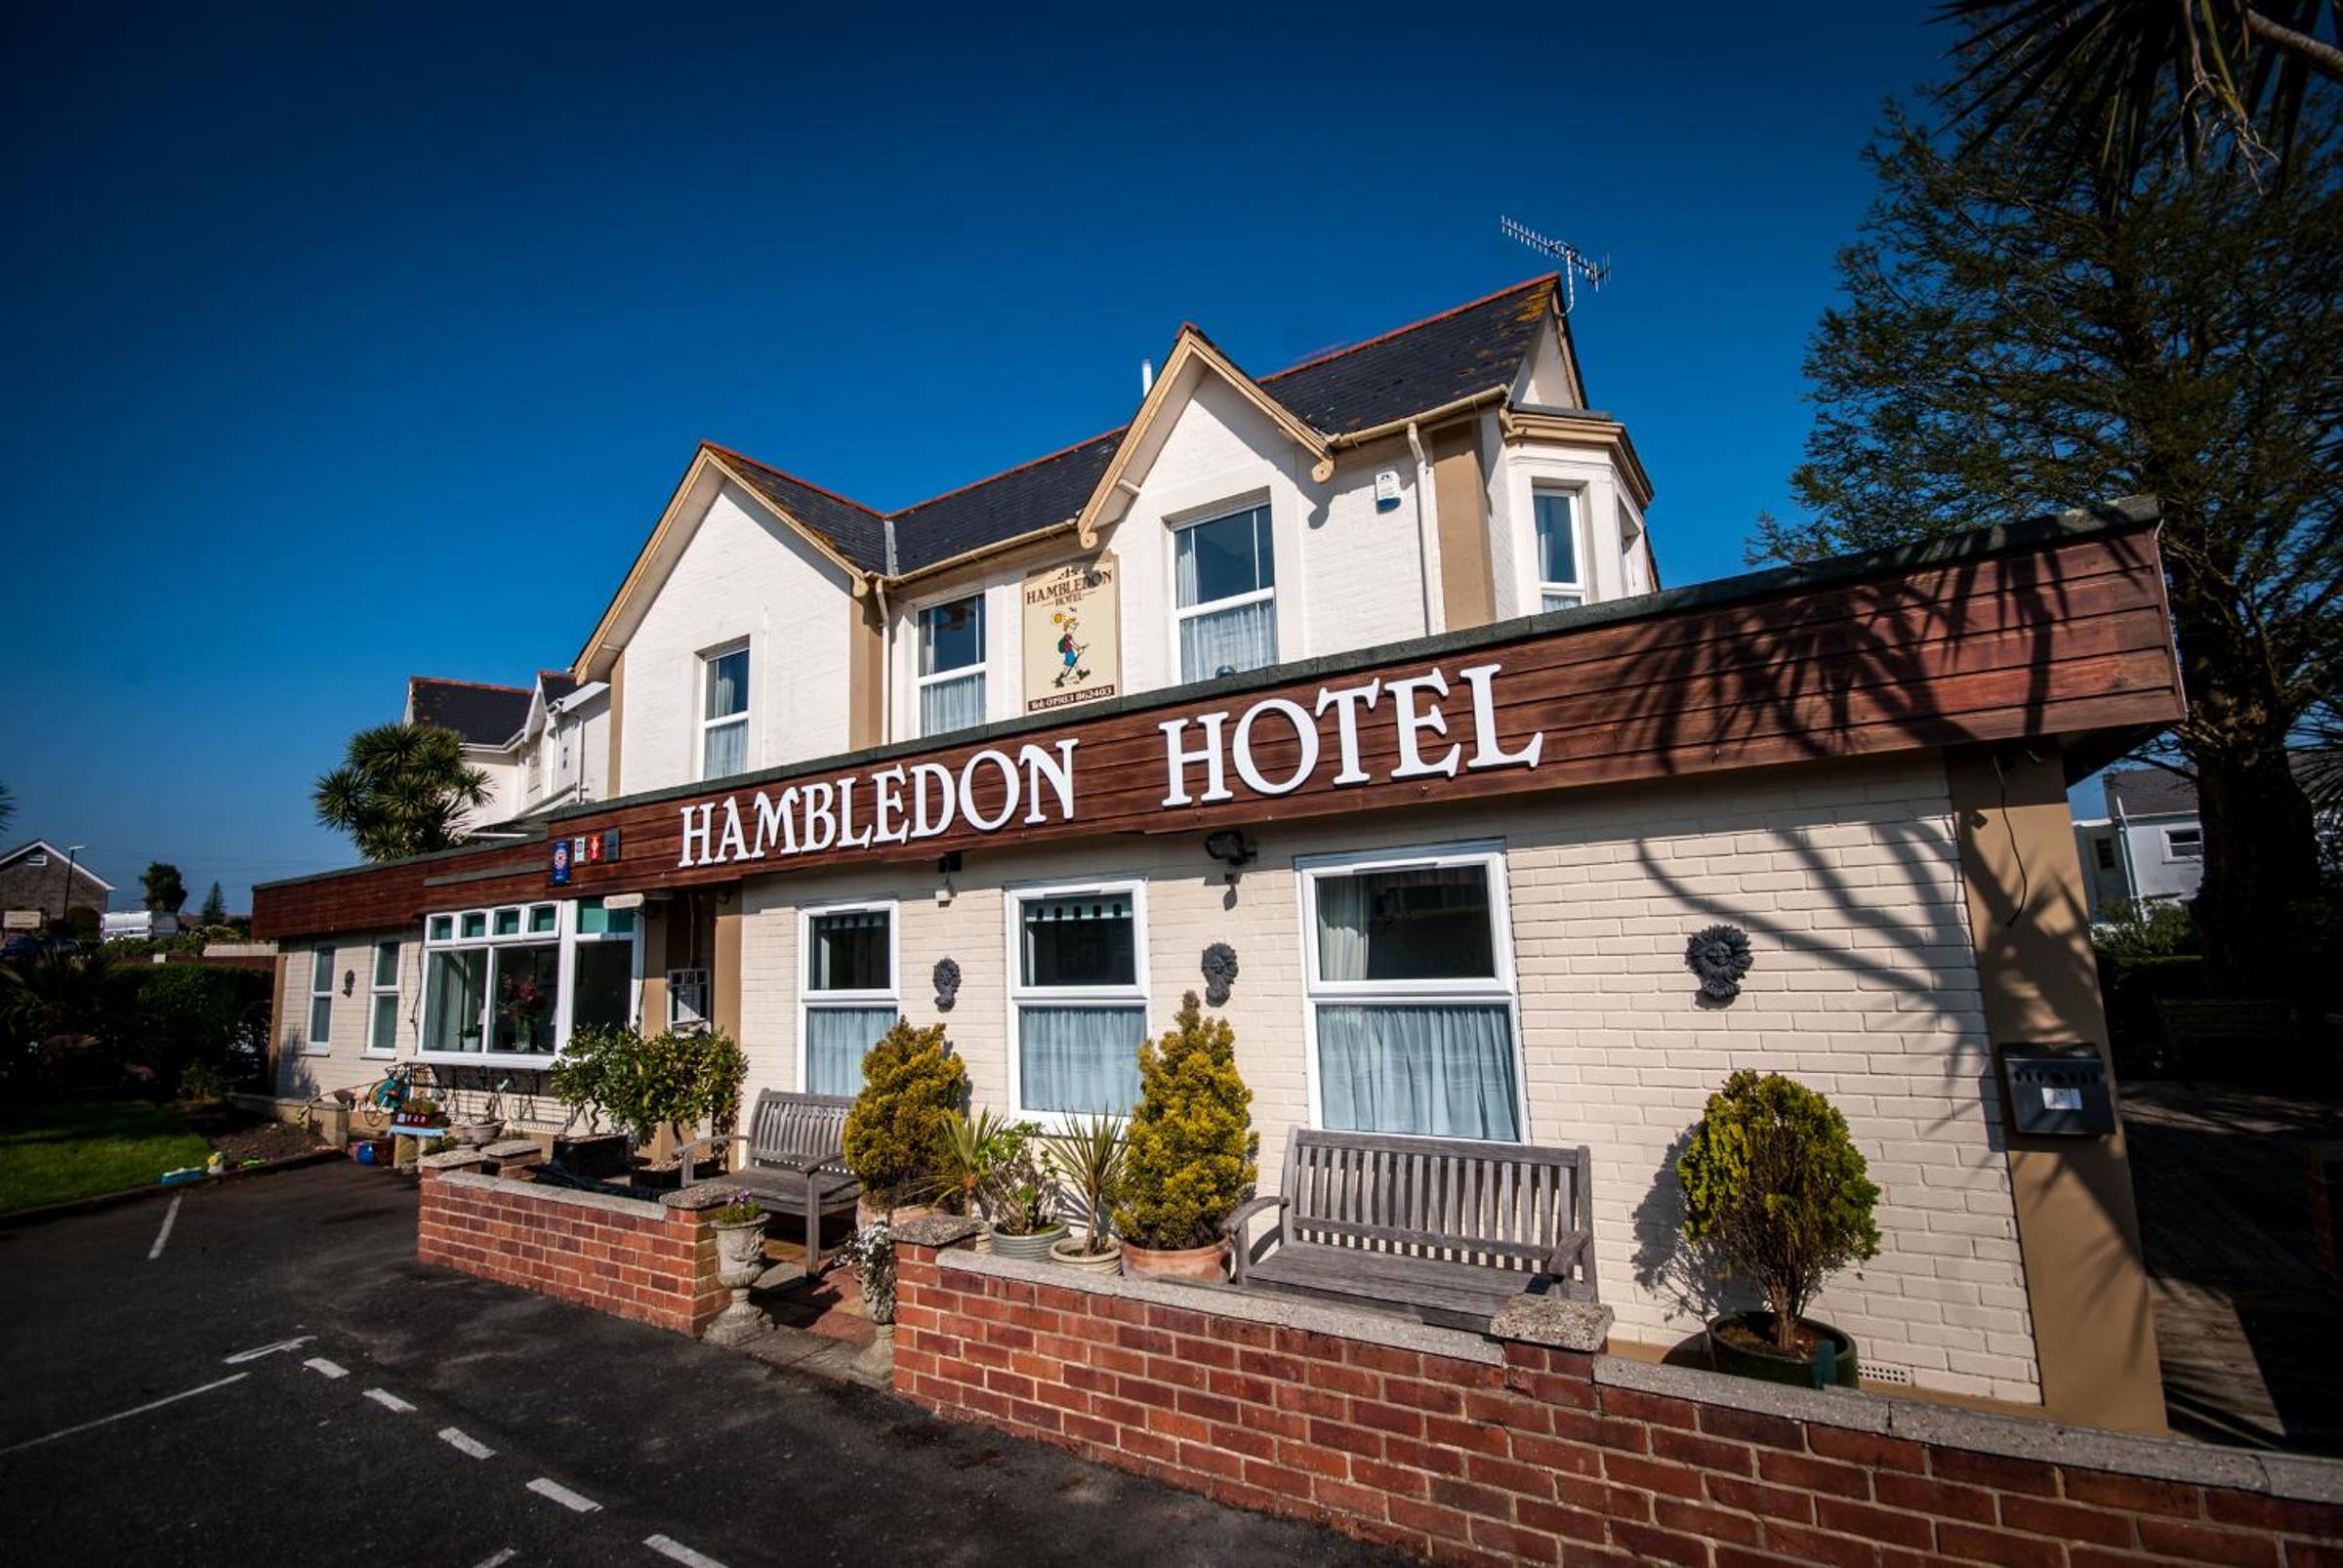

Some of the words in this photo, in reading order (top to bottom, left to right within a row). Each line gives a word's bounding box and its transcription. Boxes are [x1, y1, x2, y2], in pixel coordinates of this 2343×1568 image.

[1026, 569, 1112, 604] HAMBLEDON
[1055, 592, 1083, 606] HOTEL
[678, 738, 1080, 867] HAMBLEDON
[1158, 663, 1543, 807] HOTEL
